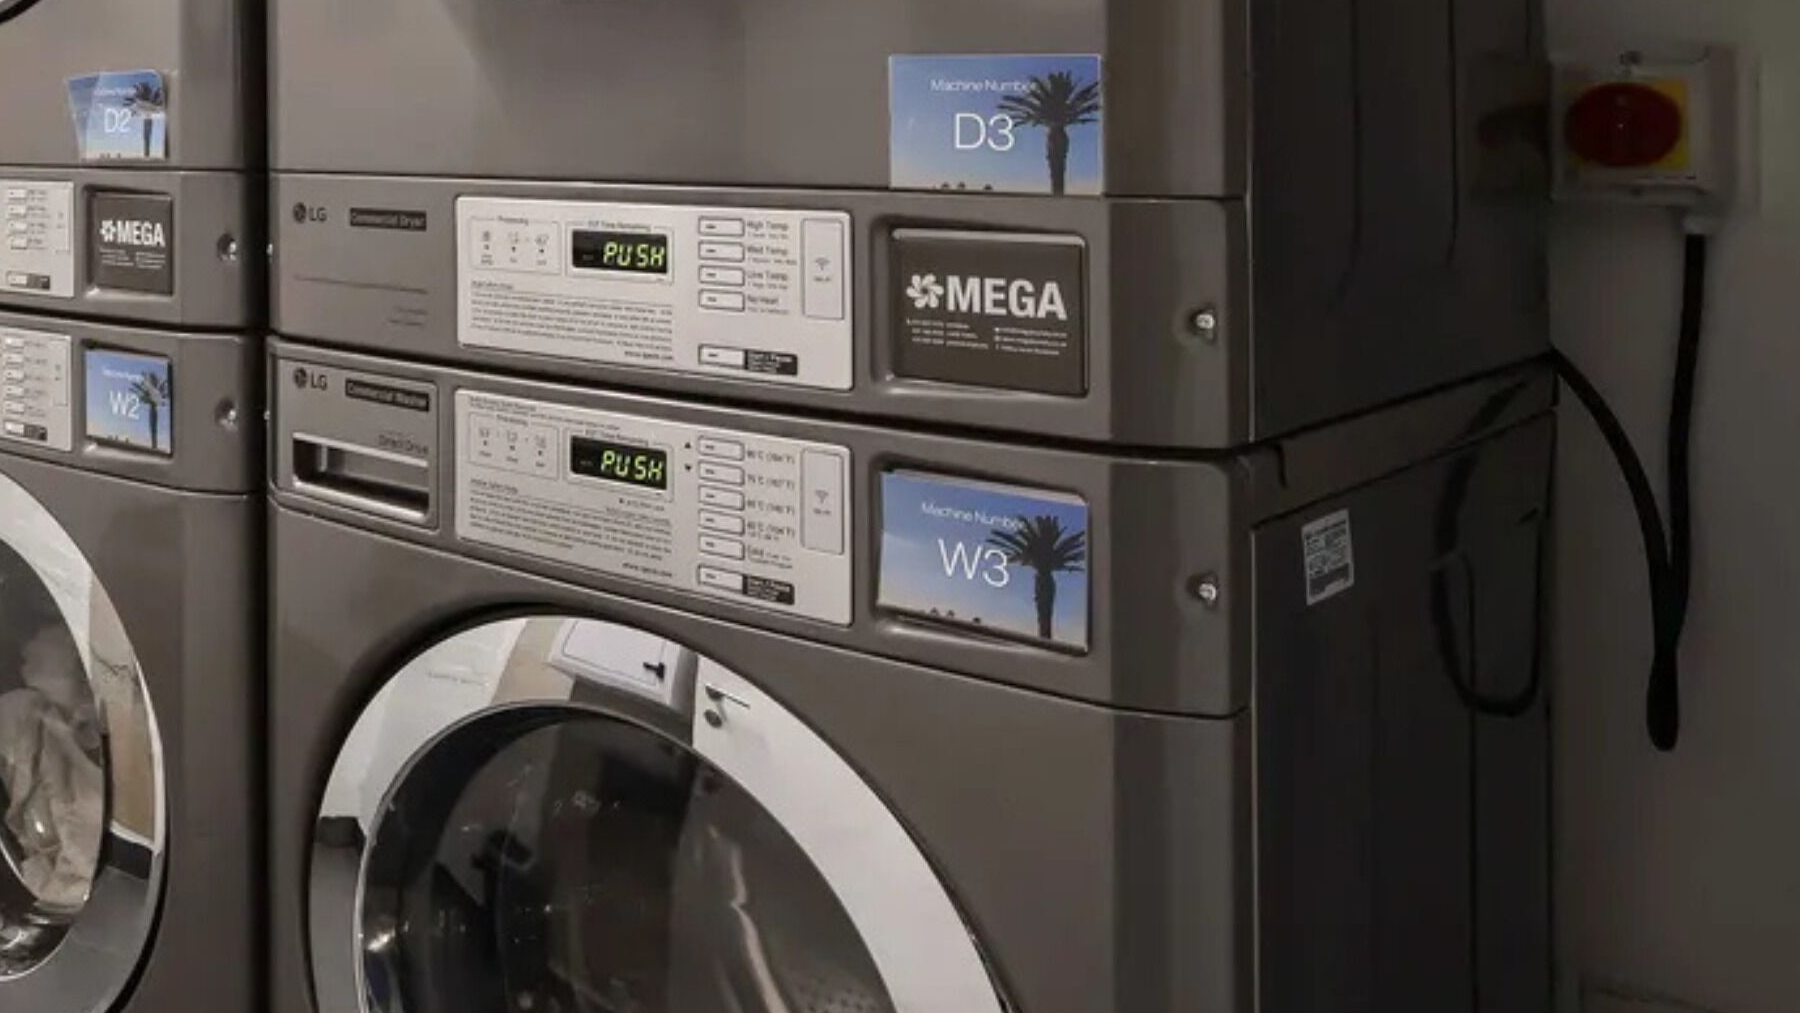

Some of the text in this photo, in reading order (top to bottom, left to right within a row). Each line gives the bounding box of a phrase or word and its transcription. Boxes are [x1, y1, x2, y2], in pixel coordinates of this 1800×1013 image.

[103, 107, 132, 134] D2
[955, 112, 1016, 152] D3
[308, 206, 327, 223] LG
[117, 219, 166, 247] MEGA
[602, 240, 666, 268] PUSH
[945, 274, 1068, 321] MEGA
[310, 371, 329, 391] LG
[109, 389, 140, 421] W2
[601, 449, 664, 481] PUSH
[937, 537, 1010, 588] W3
